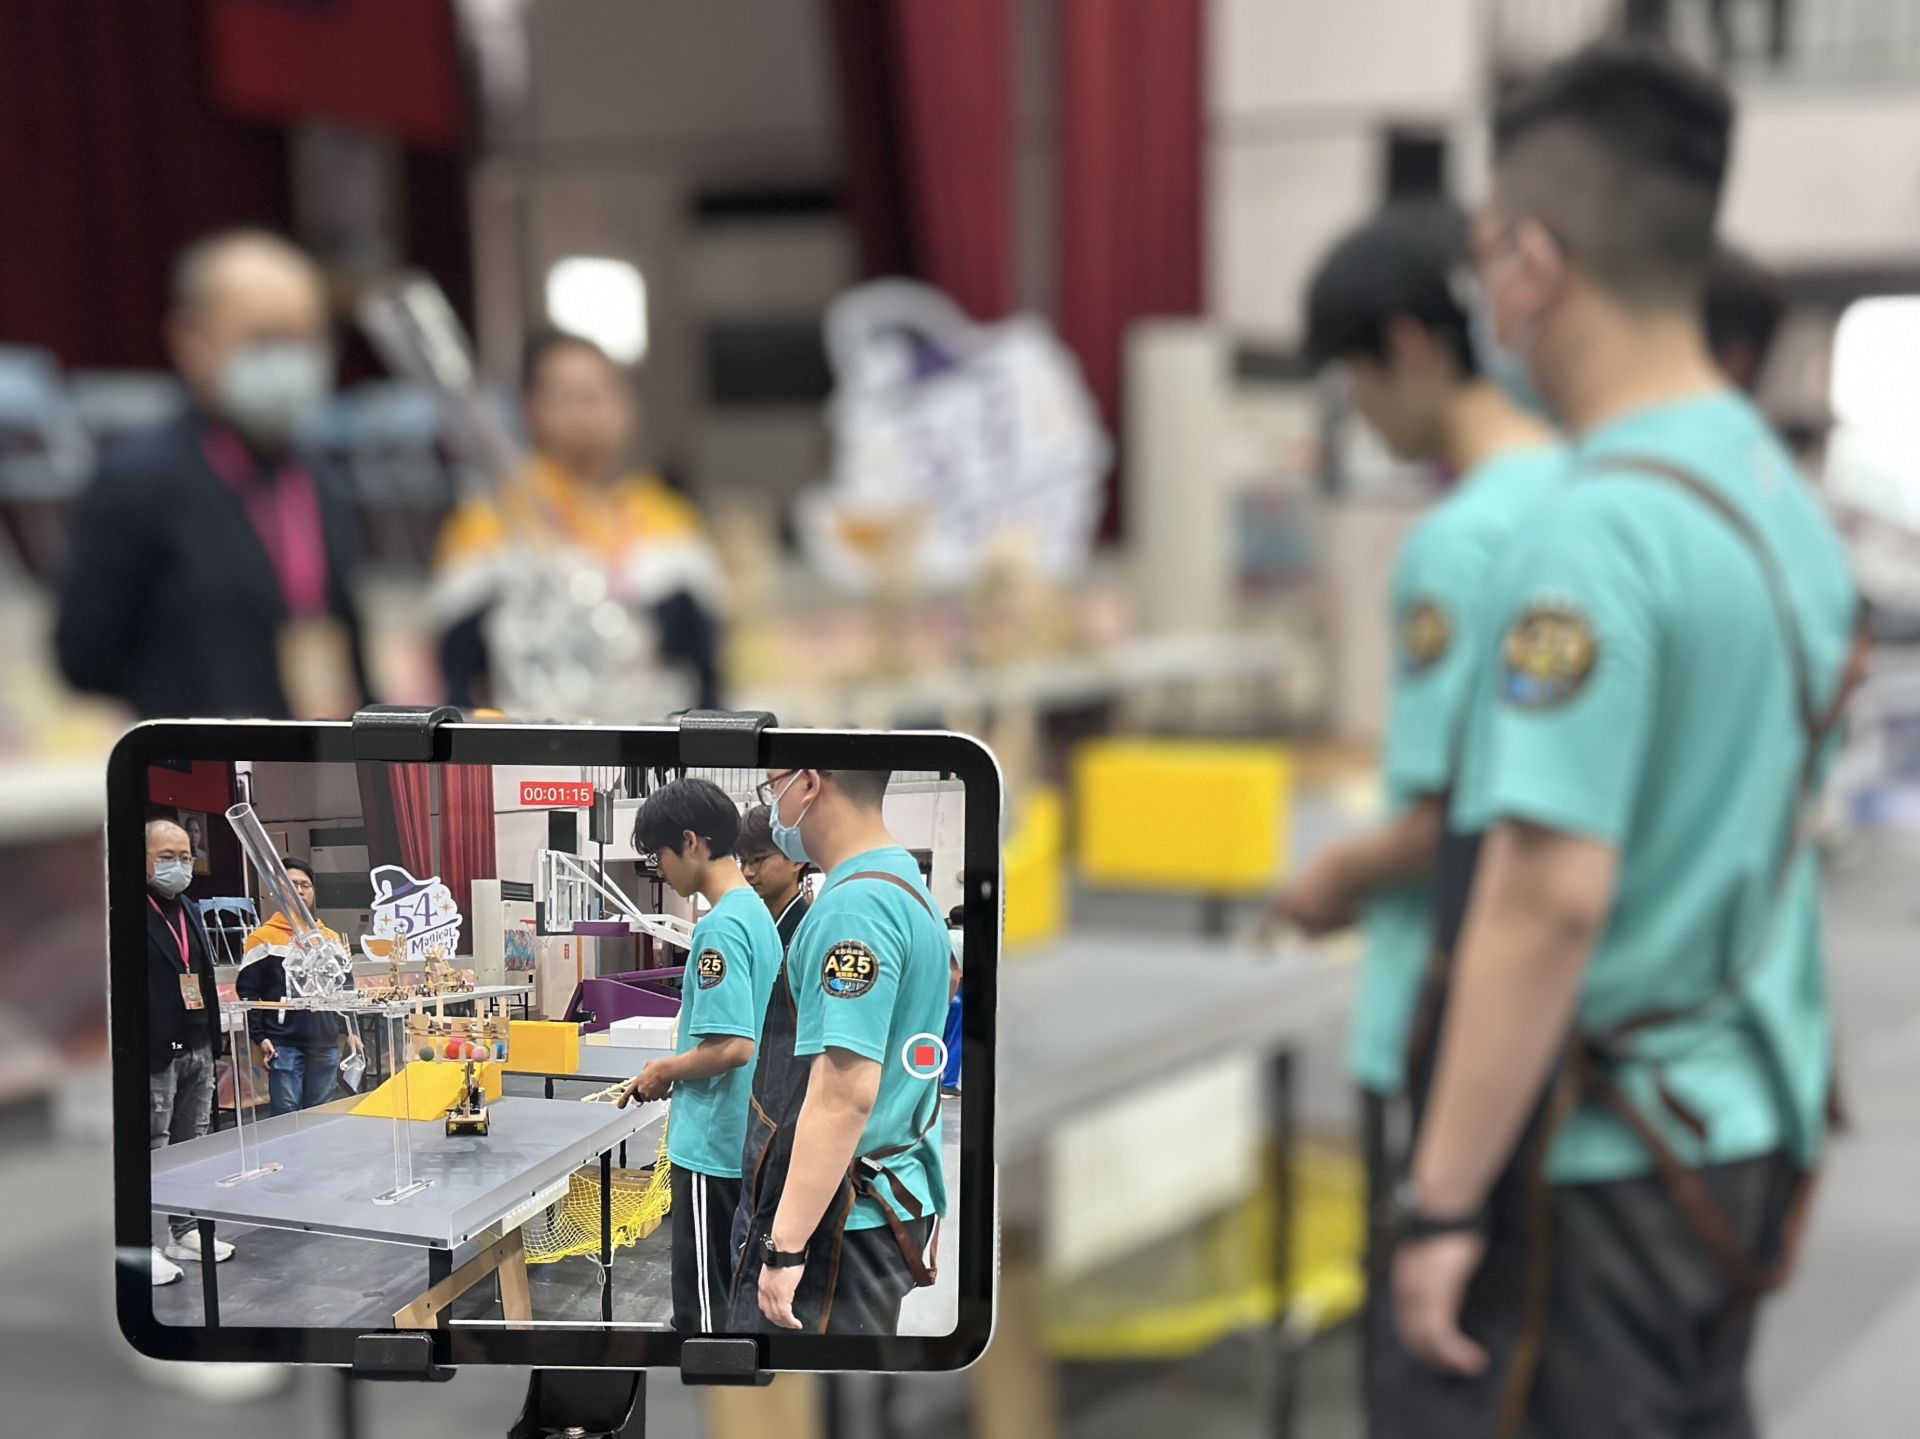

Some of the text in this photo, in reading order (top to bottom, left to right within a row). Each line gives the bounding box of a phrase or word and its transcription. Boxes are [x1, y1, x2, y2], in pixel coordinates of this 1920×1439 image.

[523, 787, 590, 802] 00:01:15
[393, 892, 439, 936] 54
[824, 954, 871, 974] A25
[170, 1041, 183, 1050] 1x
